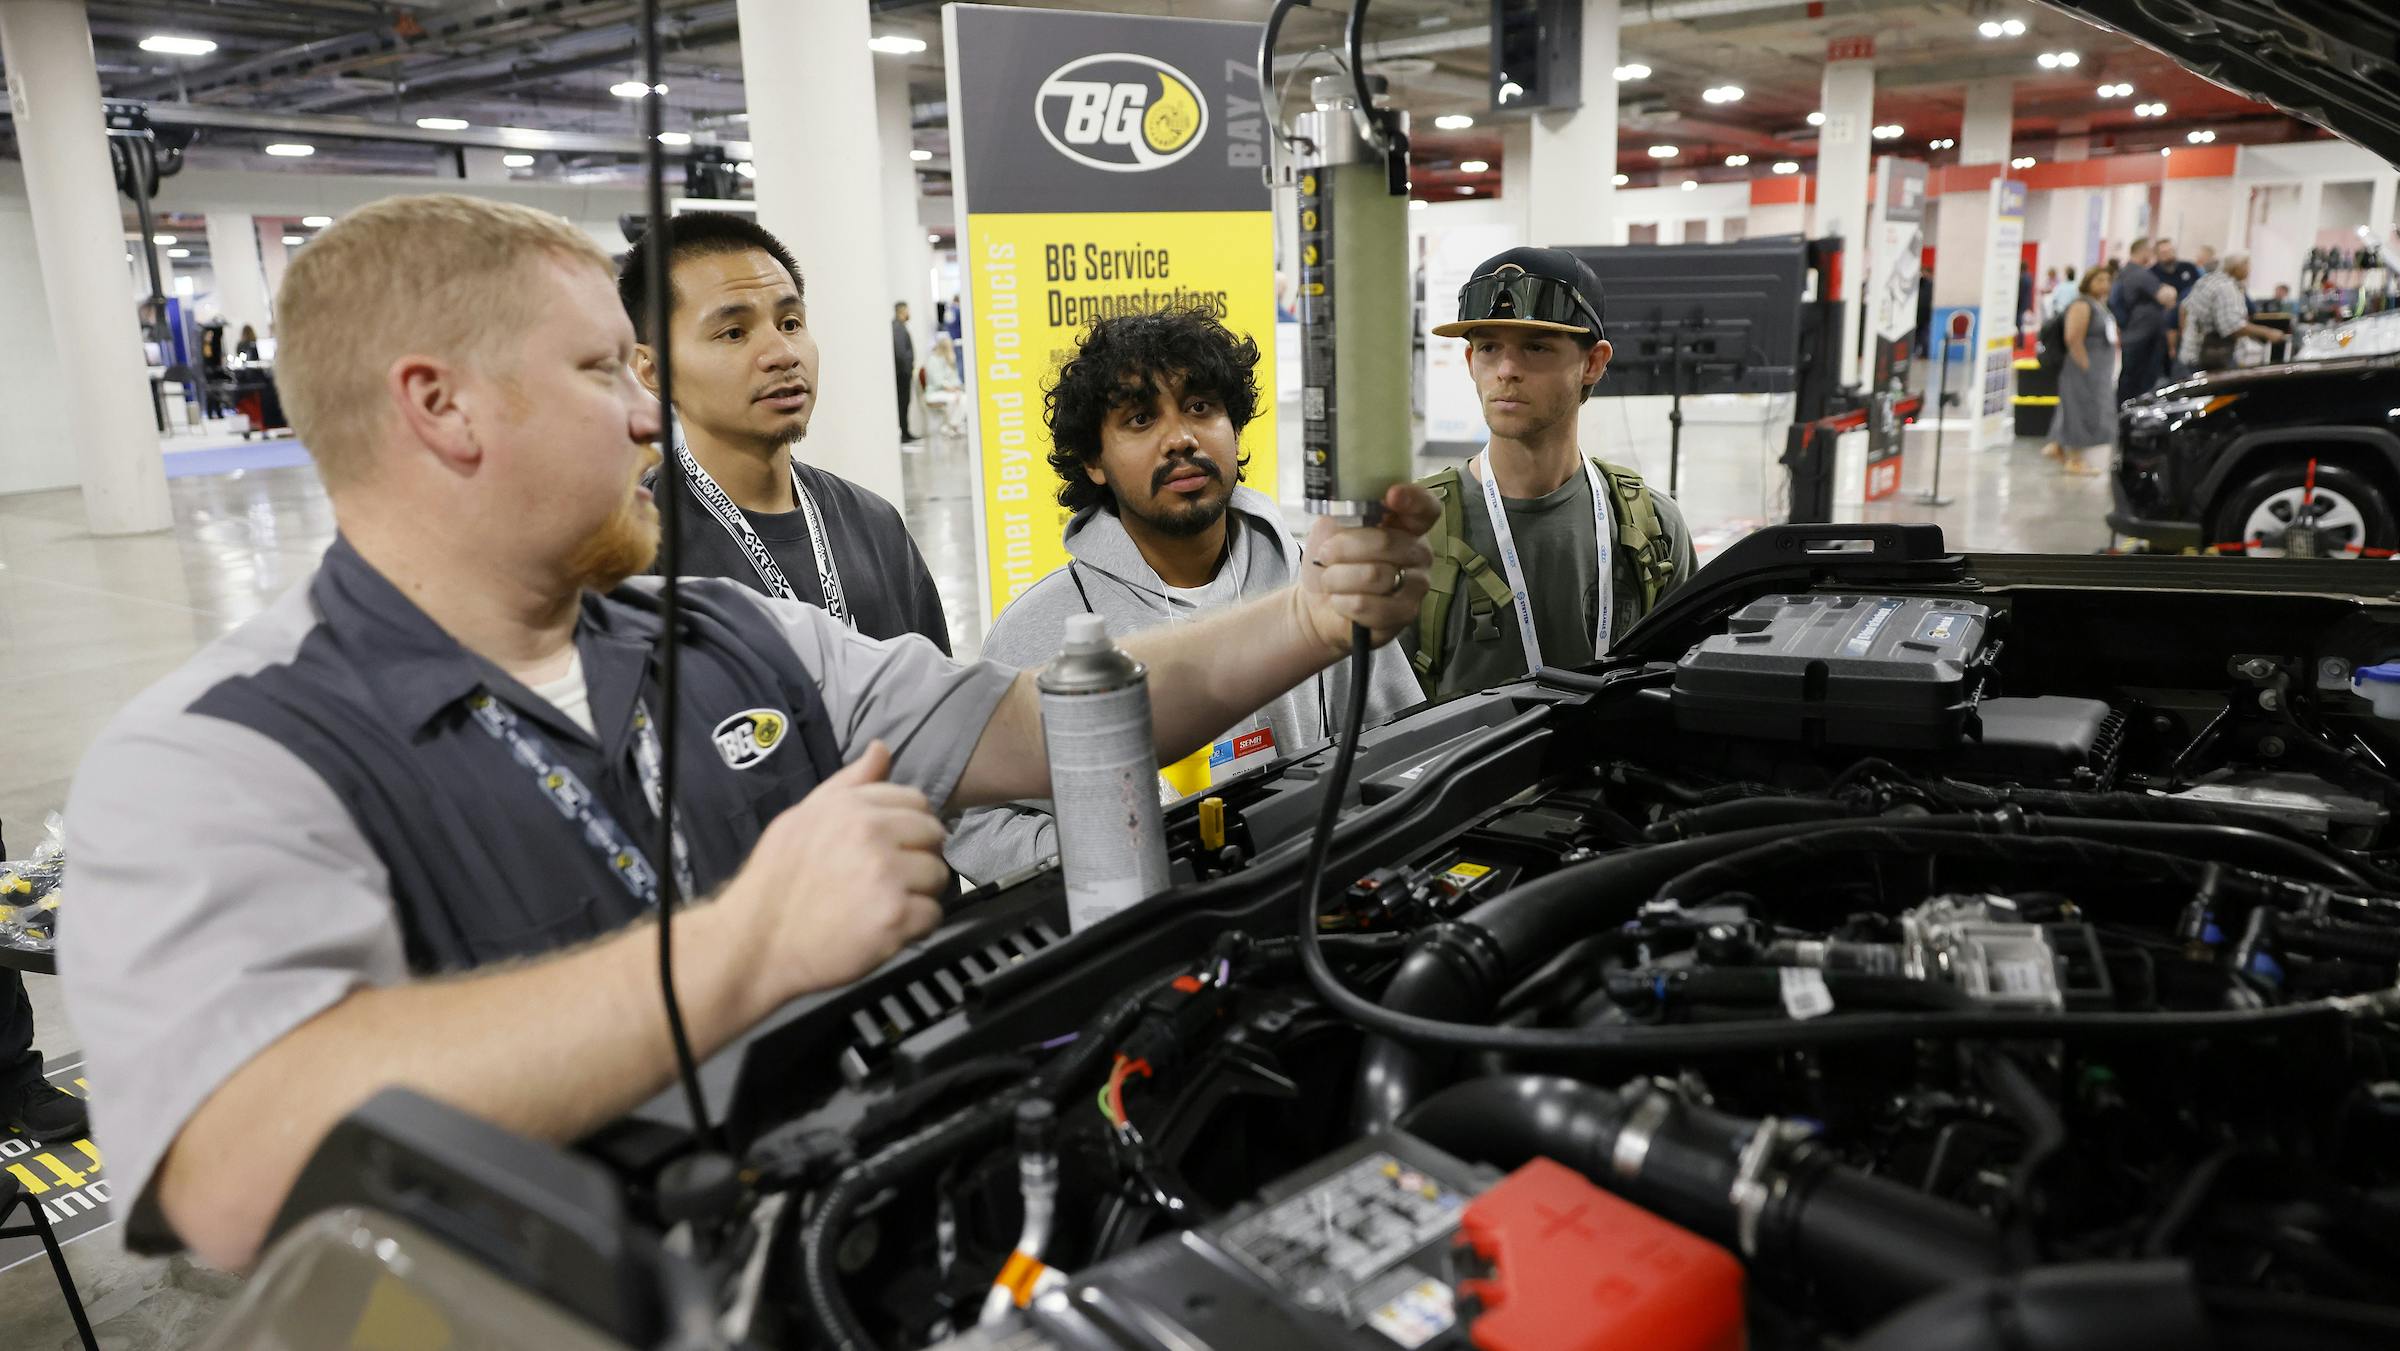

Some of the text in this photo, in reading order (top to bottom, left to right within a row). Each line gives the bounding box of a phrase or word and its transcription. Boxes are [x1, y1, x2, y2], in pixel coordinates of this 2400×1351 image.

[1225, 58, 1262, 168] BAY 7
[1046, 241, 1170, 283] BG Service
[994, 386, 1033, 502] Beyond
[695, 472, 744, 525] LIGHTING
[1002, 511, 1035, 601] artner
[1239, 735, 1262, 749] SEMA
